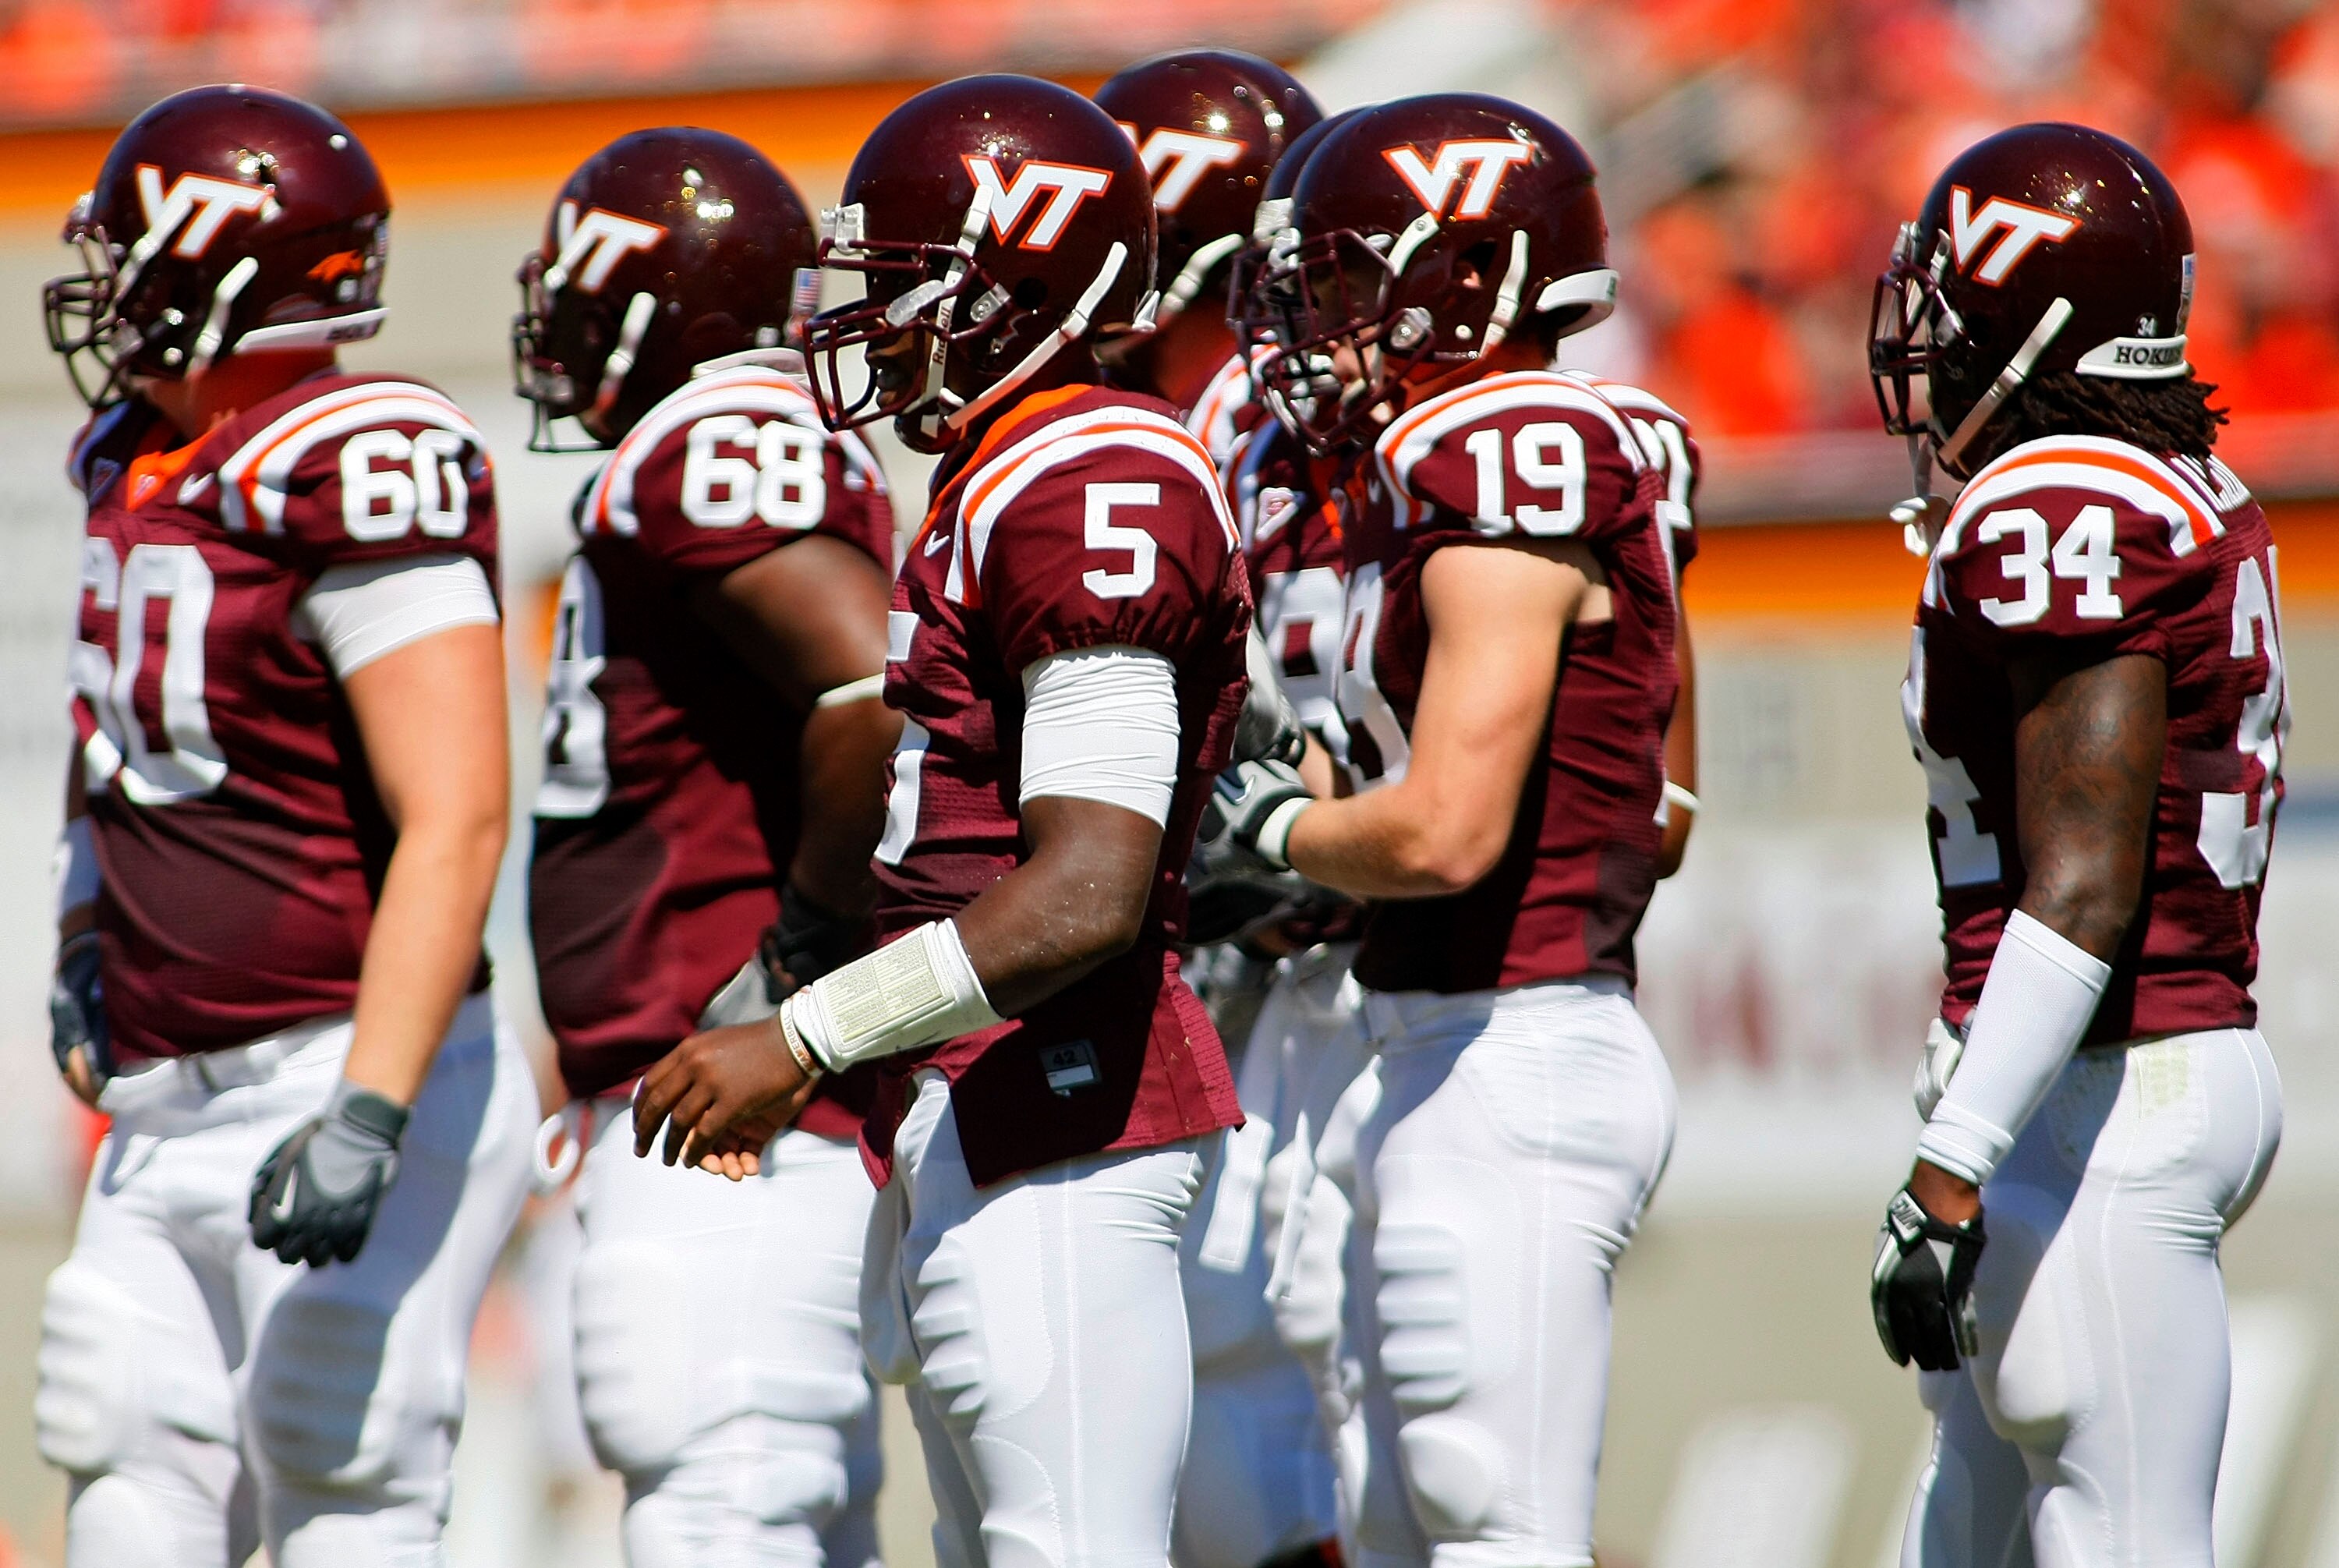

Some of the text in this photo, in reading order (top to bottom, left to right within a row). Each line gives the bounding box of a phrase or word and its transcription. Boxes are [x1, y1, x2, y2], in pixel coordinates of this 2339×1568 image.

[136, 163, 278, 259] VT
[961, 154, 1113, 251] VT
[1380, 138, 1534, 221] VT
[555, 199, 669, 294] VT
[1950, 184, 2082, 288] VT
[932, 306, 951, 365] Riell
[2137, 317, 2157, 337] 34
[340, 429, 469, 541] 60
[681, 415, 826, 529] 68
[1465, 422, 1587, 539] 19
[1082, 482, 1161, 600] 5
[1978, 504, 2124, 627] 34
[2196, 544, 2292, 889] 3
